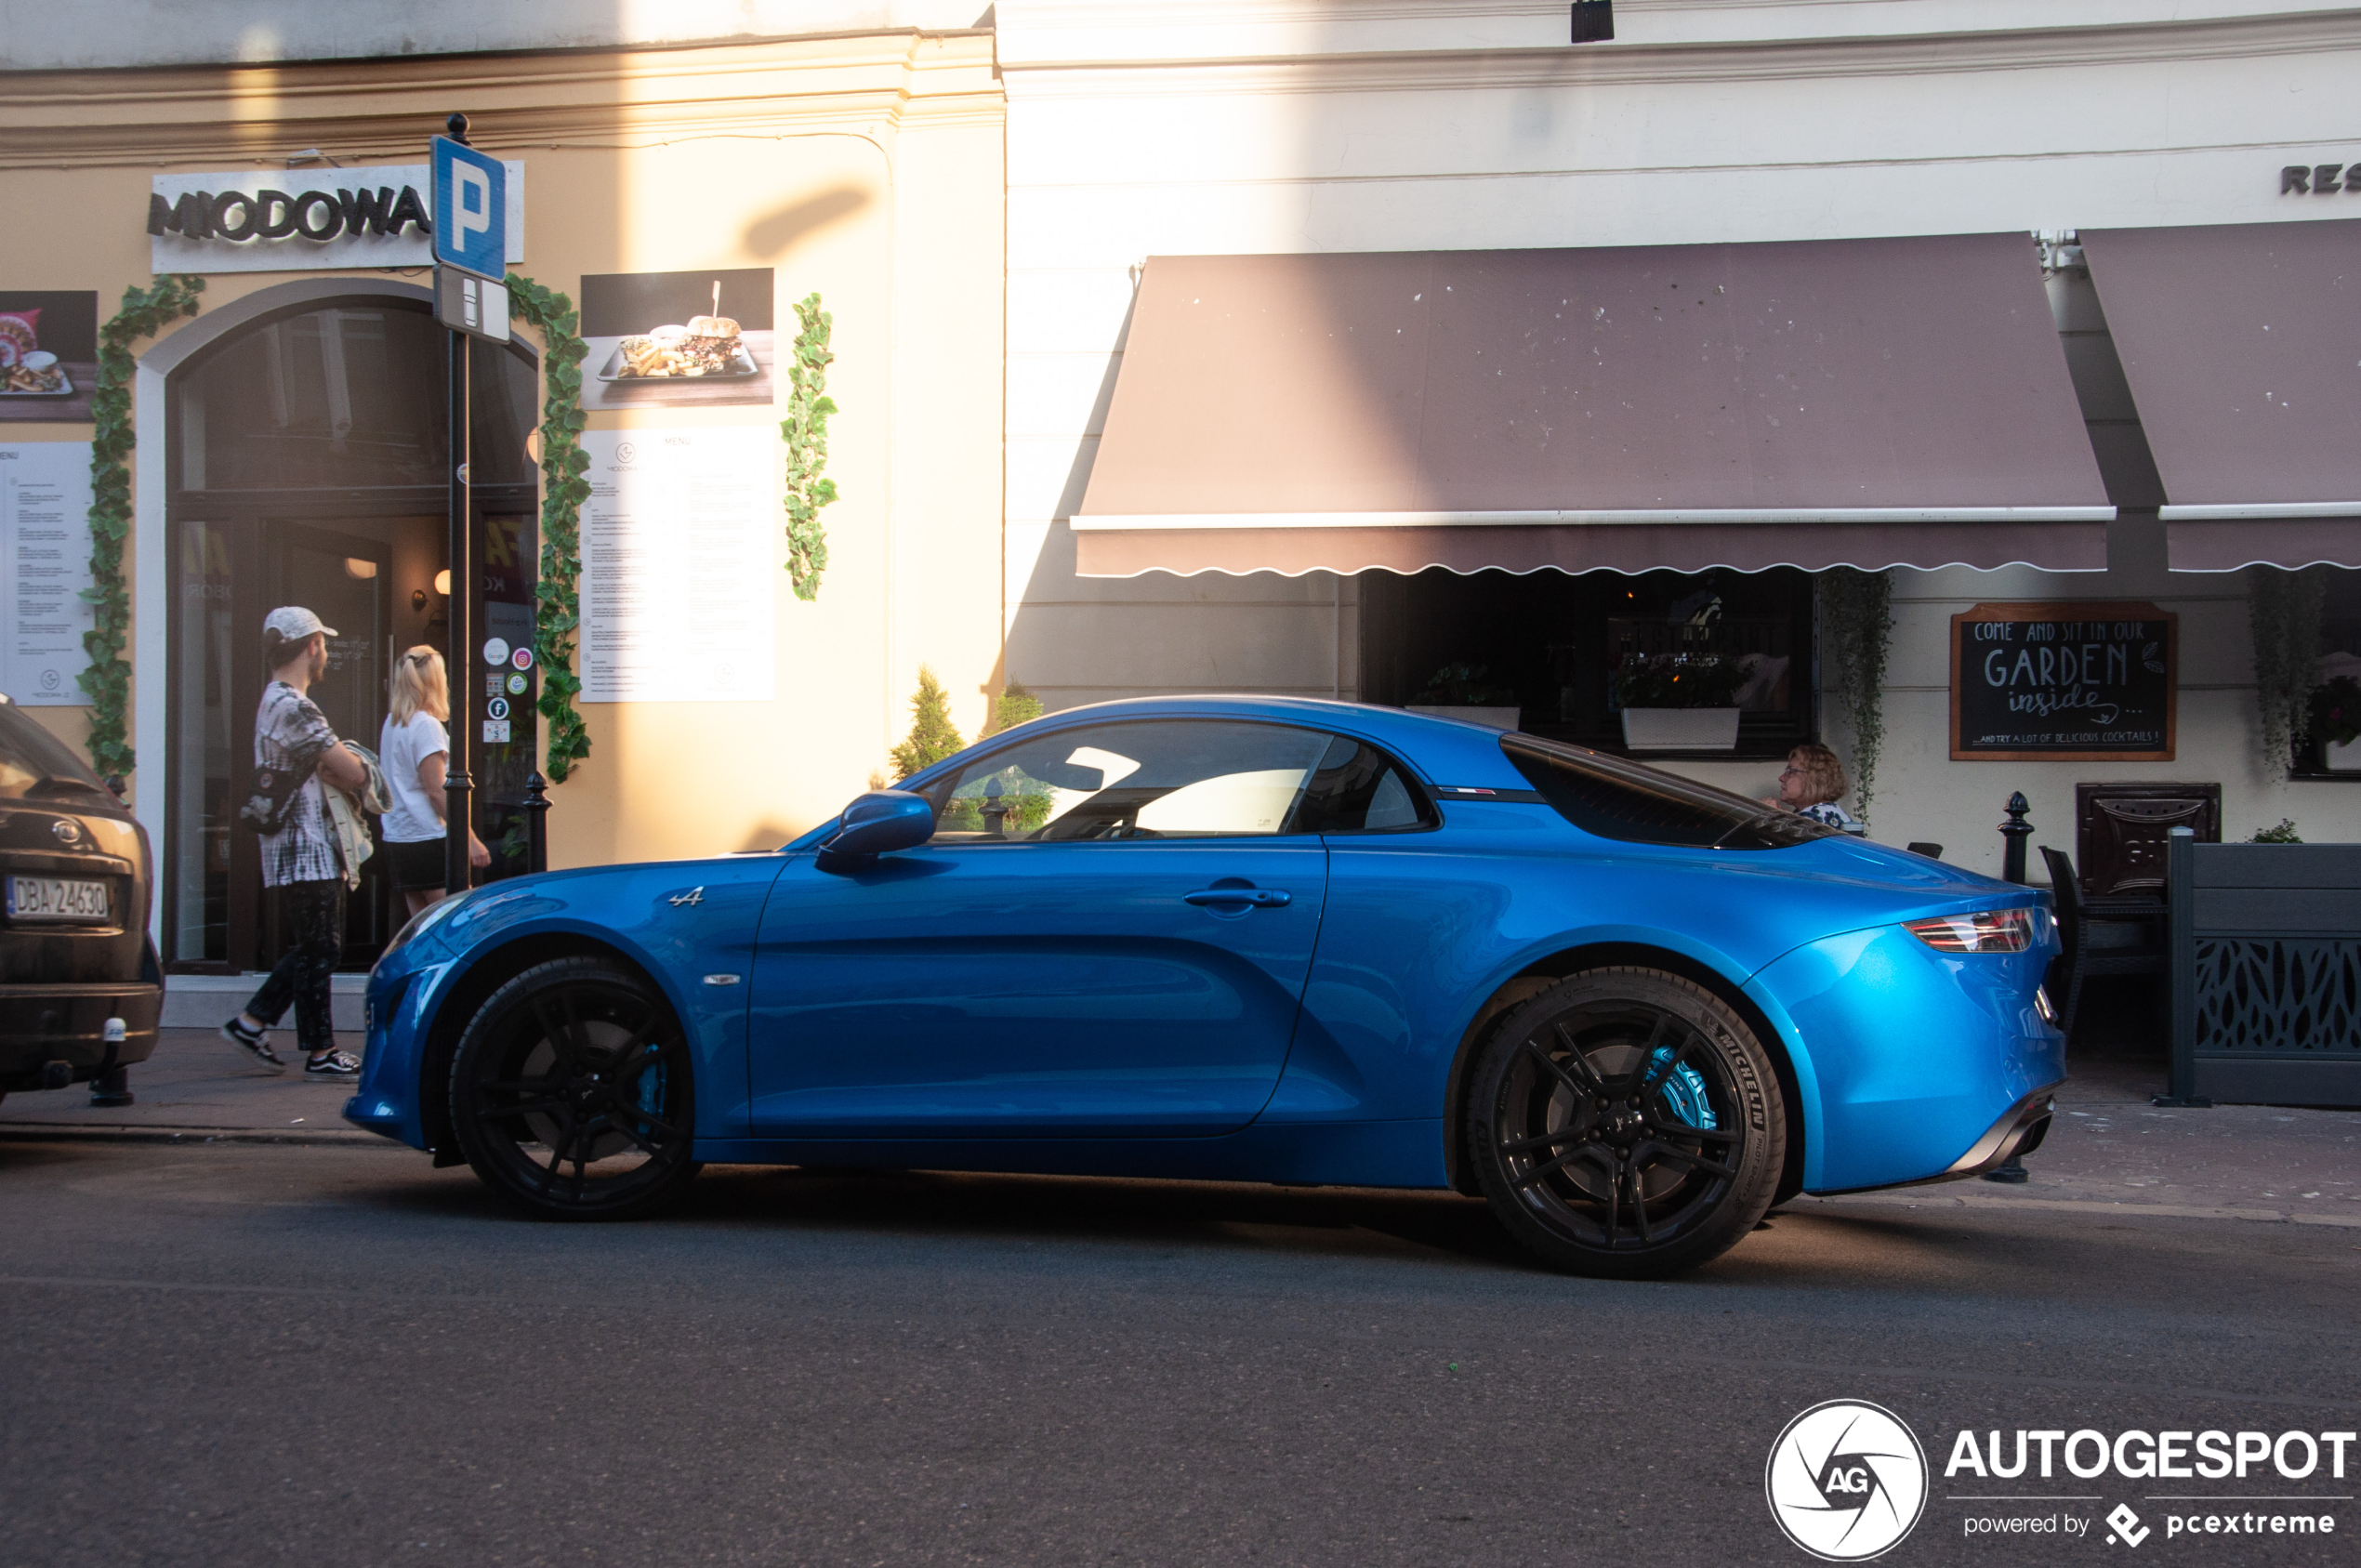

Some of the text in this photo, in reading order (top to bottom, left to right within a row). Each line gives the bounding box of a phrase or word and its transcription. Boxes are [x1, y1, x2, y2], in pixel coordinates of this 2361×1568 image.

[147, 185, 431, 242] MIODOWA
[452, 157, 490, 253] P
[0, 451, 19, 460] ENU
[665, 437, 692, 445] MENU
[1974, 622, 2144, 641] COME AND SIT IN OUR
[1985, 643, 2127, 687] GARDEN
[2009, 683, 2108, 718] inside
[2013, 734, 2019, 744] A
[2022, 733, 2038, 743] LOT
[2040, 733, 2051, 743] OF
[2055, 732, 2099, 743] DELICIOUS
[17, 879, 106, 915] DBA 24630
[1719, 1034, 1764, 1126] MICHELIN
[1745, 1138, 1763, 1192] PILOT SPORT
